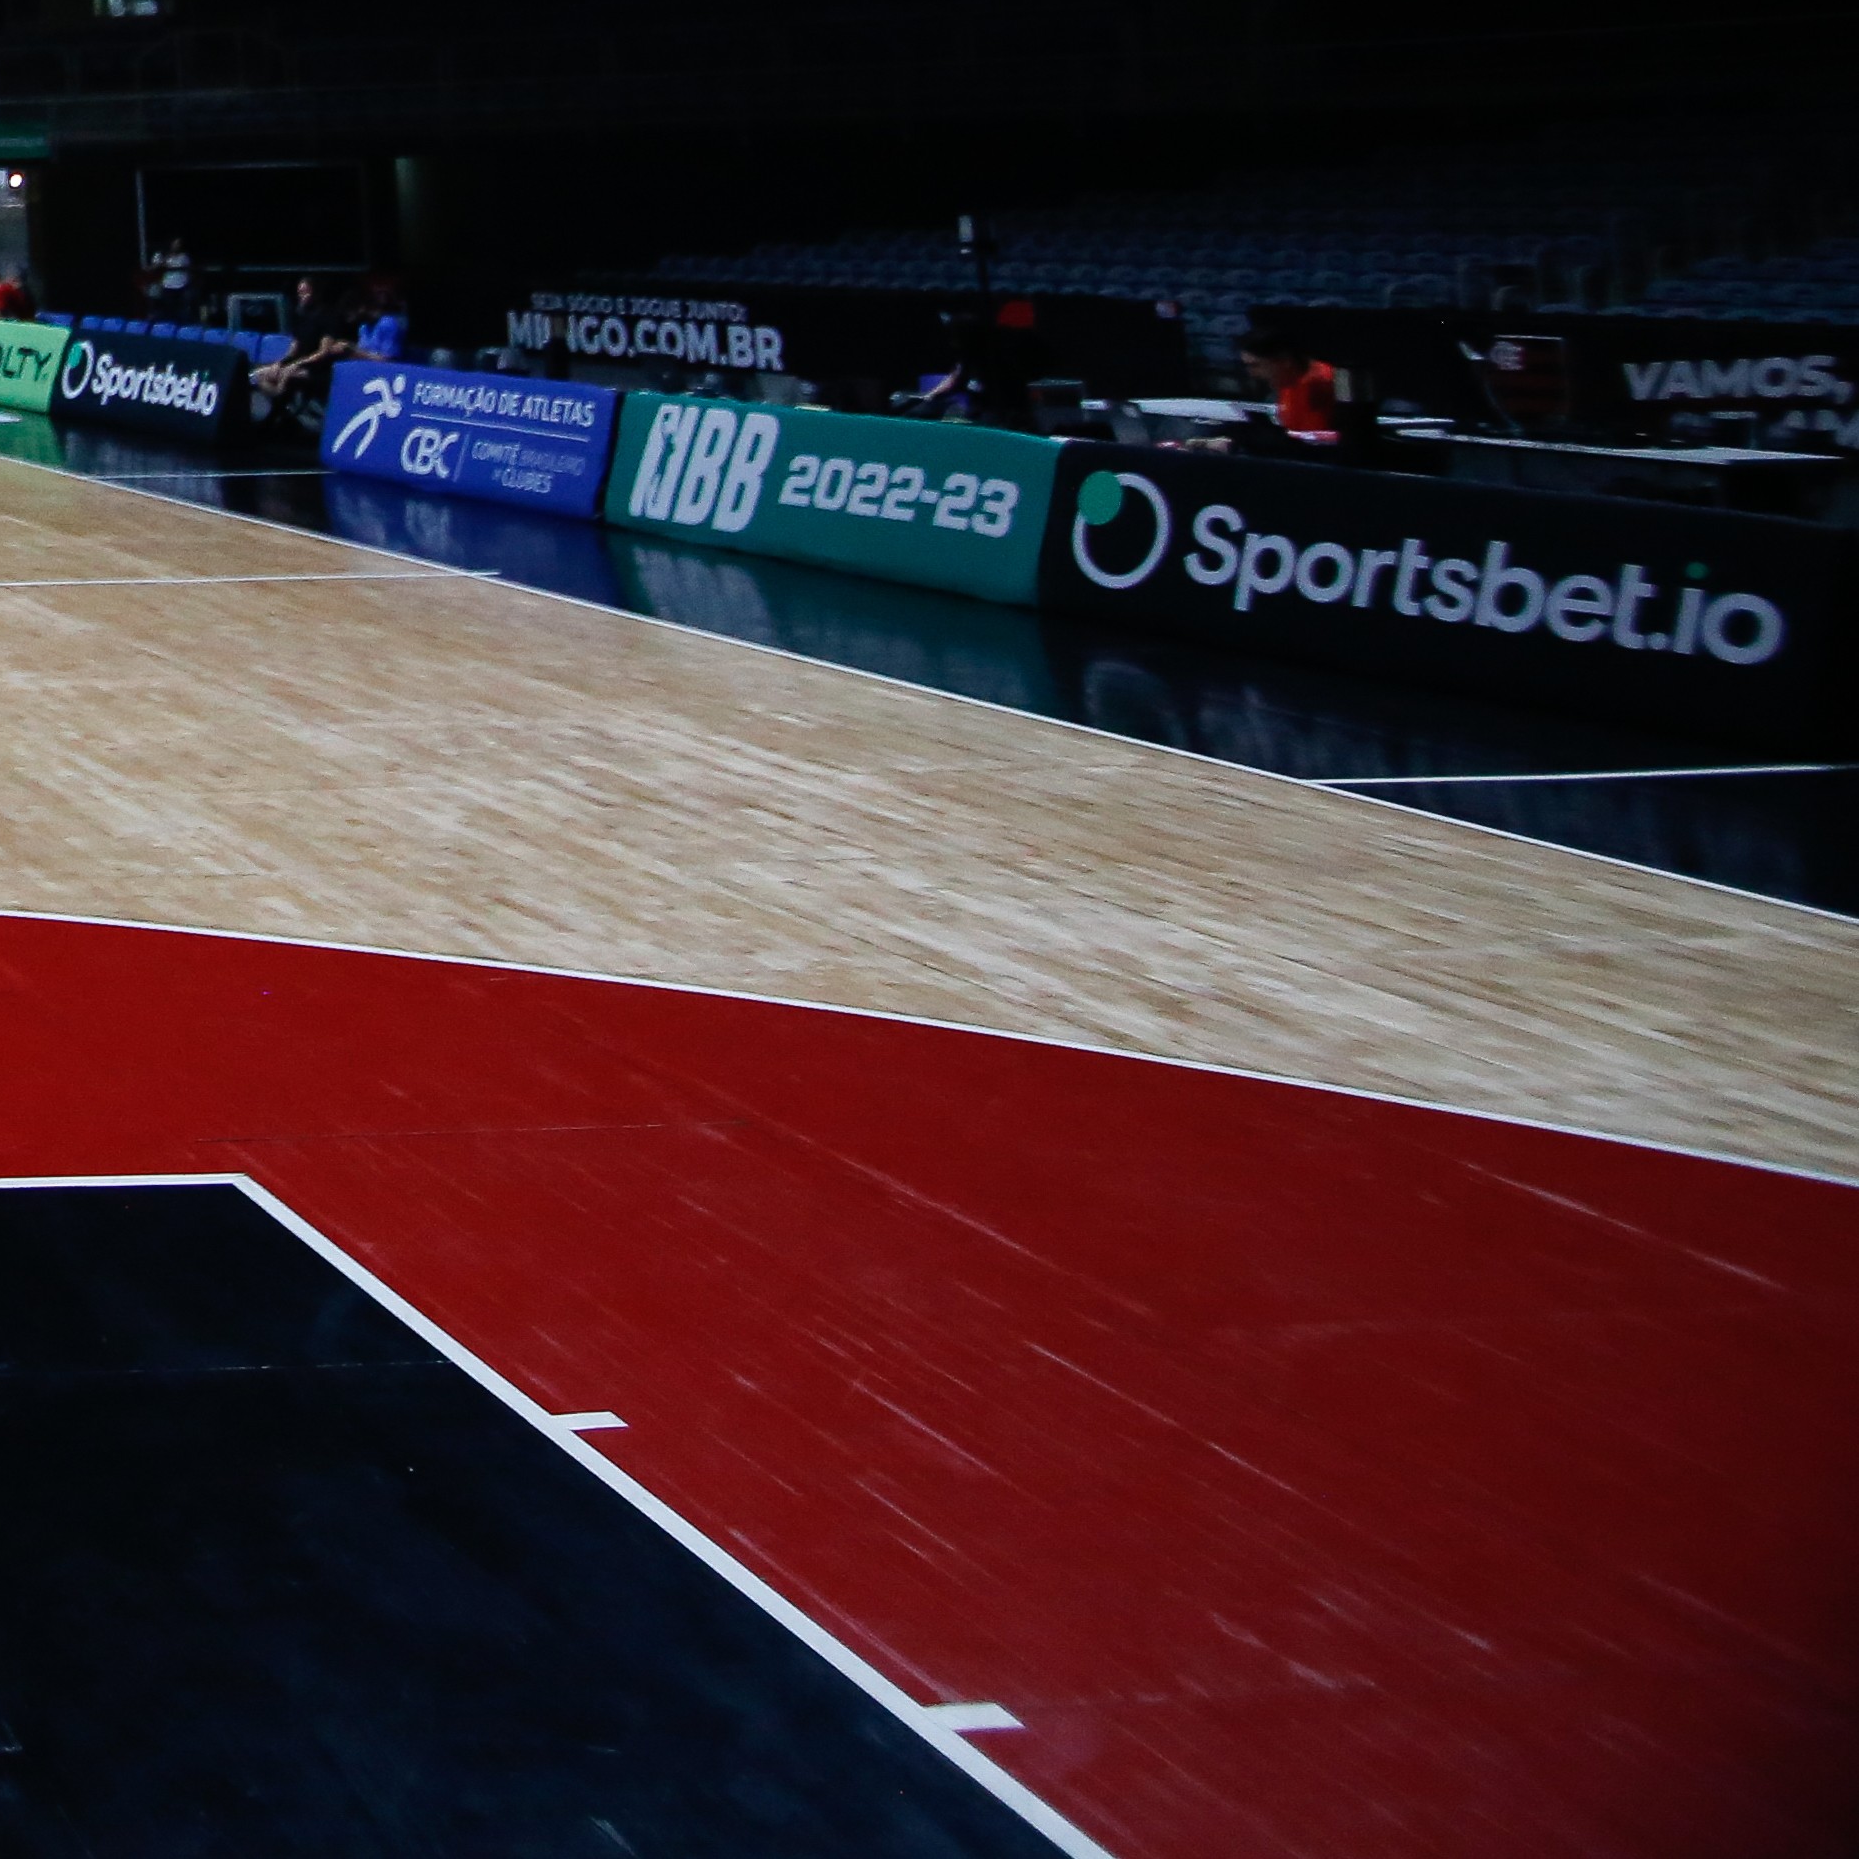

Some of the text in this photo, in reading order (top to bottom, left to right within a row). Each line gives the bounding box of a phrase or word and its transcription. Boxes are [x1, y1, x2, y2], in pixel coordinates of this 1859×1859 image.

[91, 350, 219, 417] Sportsbet.io
[412, 379, 597, 429] FORMAÇÃO DE ATLETAS
[400, 426, 460, 479] CBC
[779, 454, 1022, 539] 2022-23
[1183, 503, 1784, 666] Sportsbet.io
